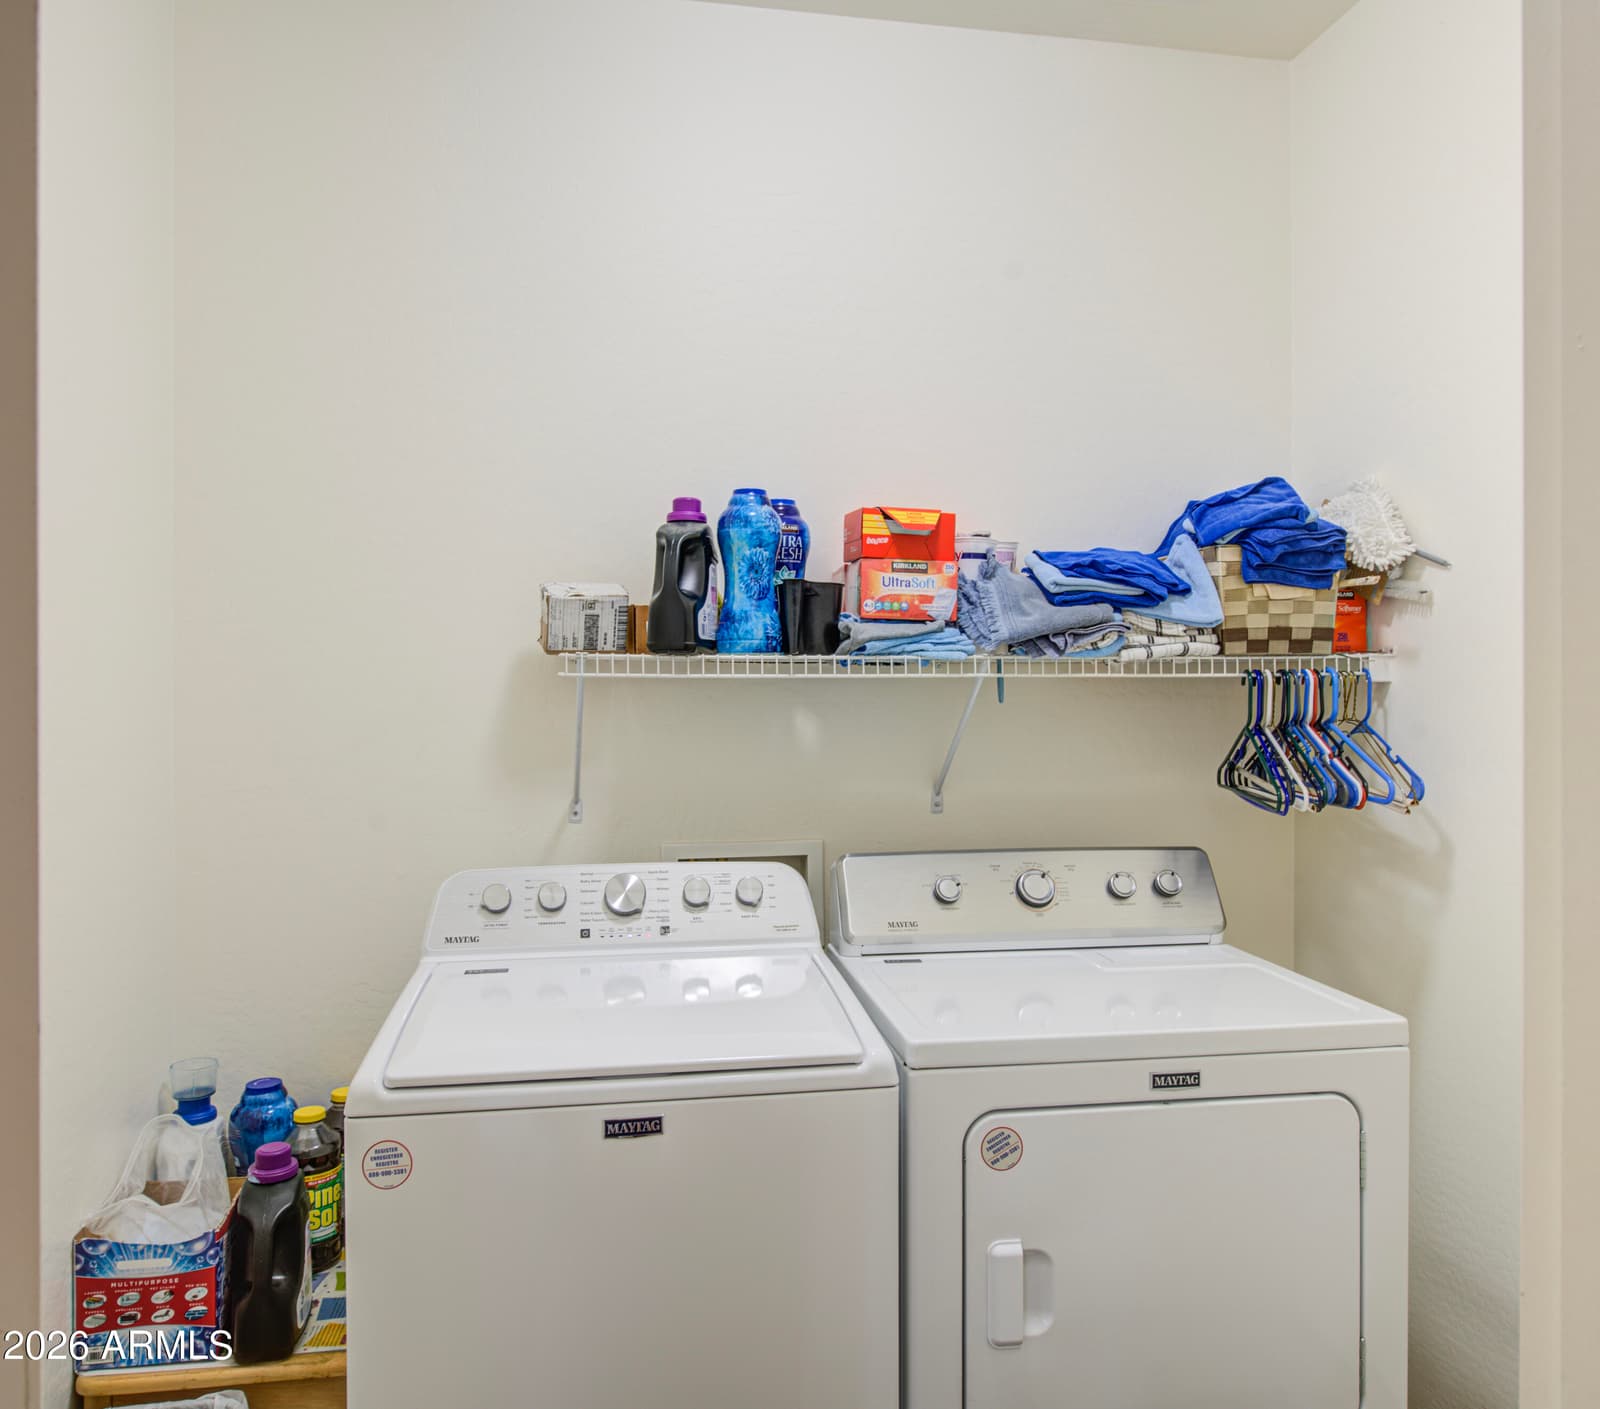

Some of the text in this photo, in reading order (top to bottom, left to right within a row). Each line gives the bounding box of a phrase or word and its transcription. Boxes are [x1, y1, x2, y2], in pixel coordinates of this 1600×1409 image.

[782, 535, 803, 547] TRA
[892, 562, 928, 570] KIRKLAND
[882, 575, 936, 589] UltraSoft
[888, 921, 919, 929] MAYTAG
[444, 935, 480, 944] MAYTAG
[1154, 1074, 1199, 1087] MAYTAG
[606, 1119, 661, 1135] MAYTAG
[309, 1202, 337, 1230] Sol
[110, 1278, 180, 1289] MULTIPURPOSE
